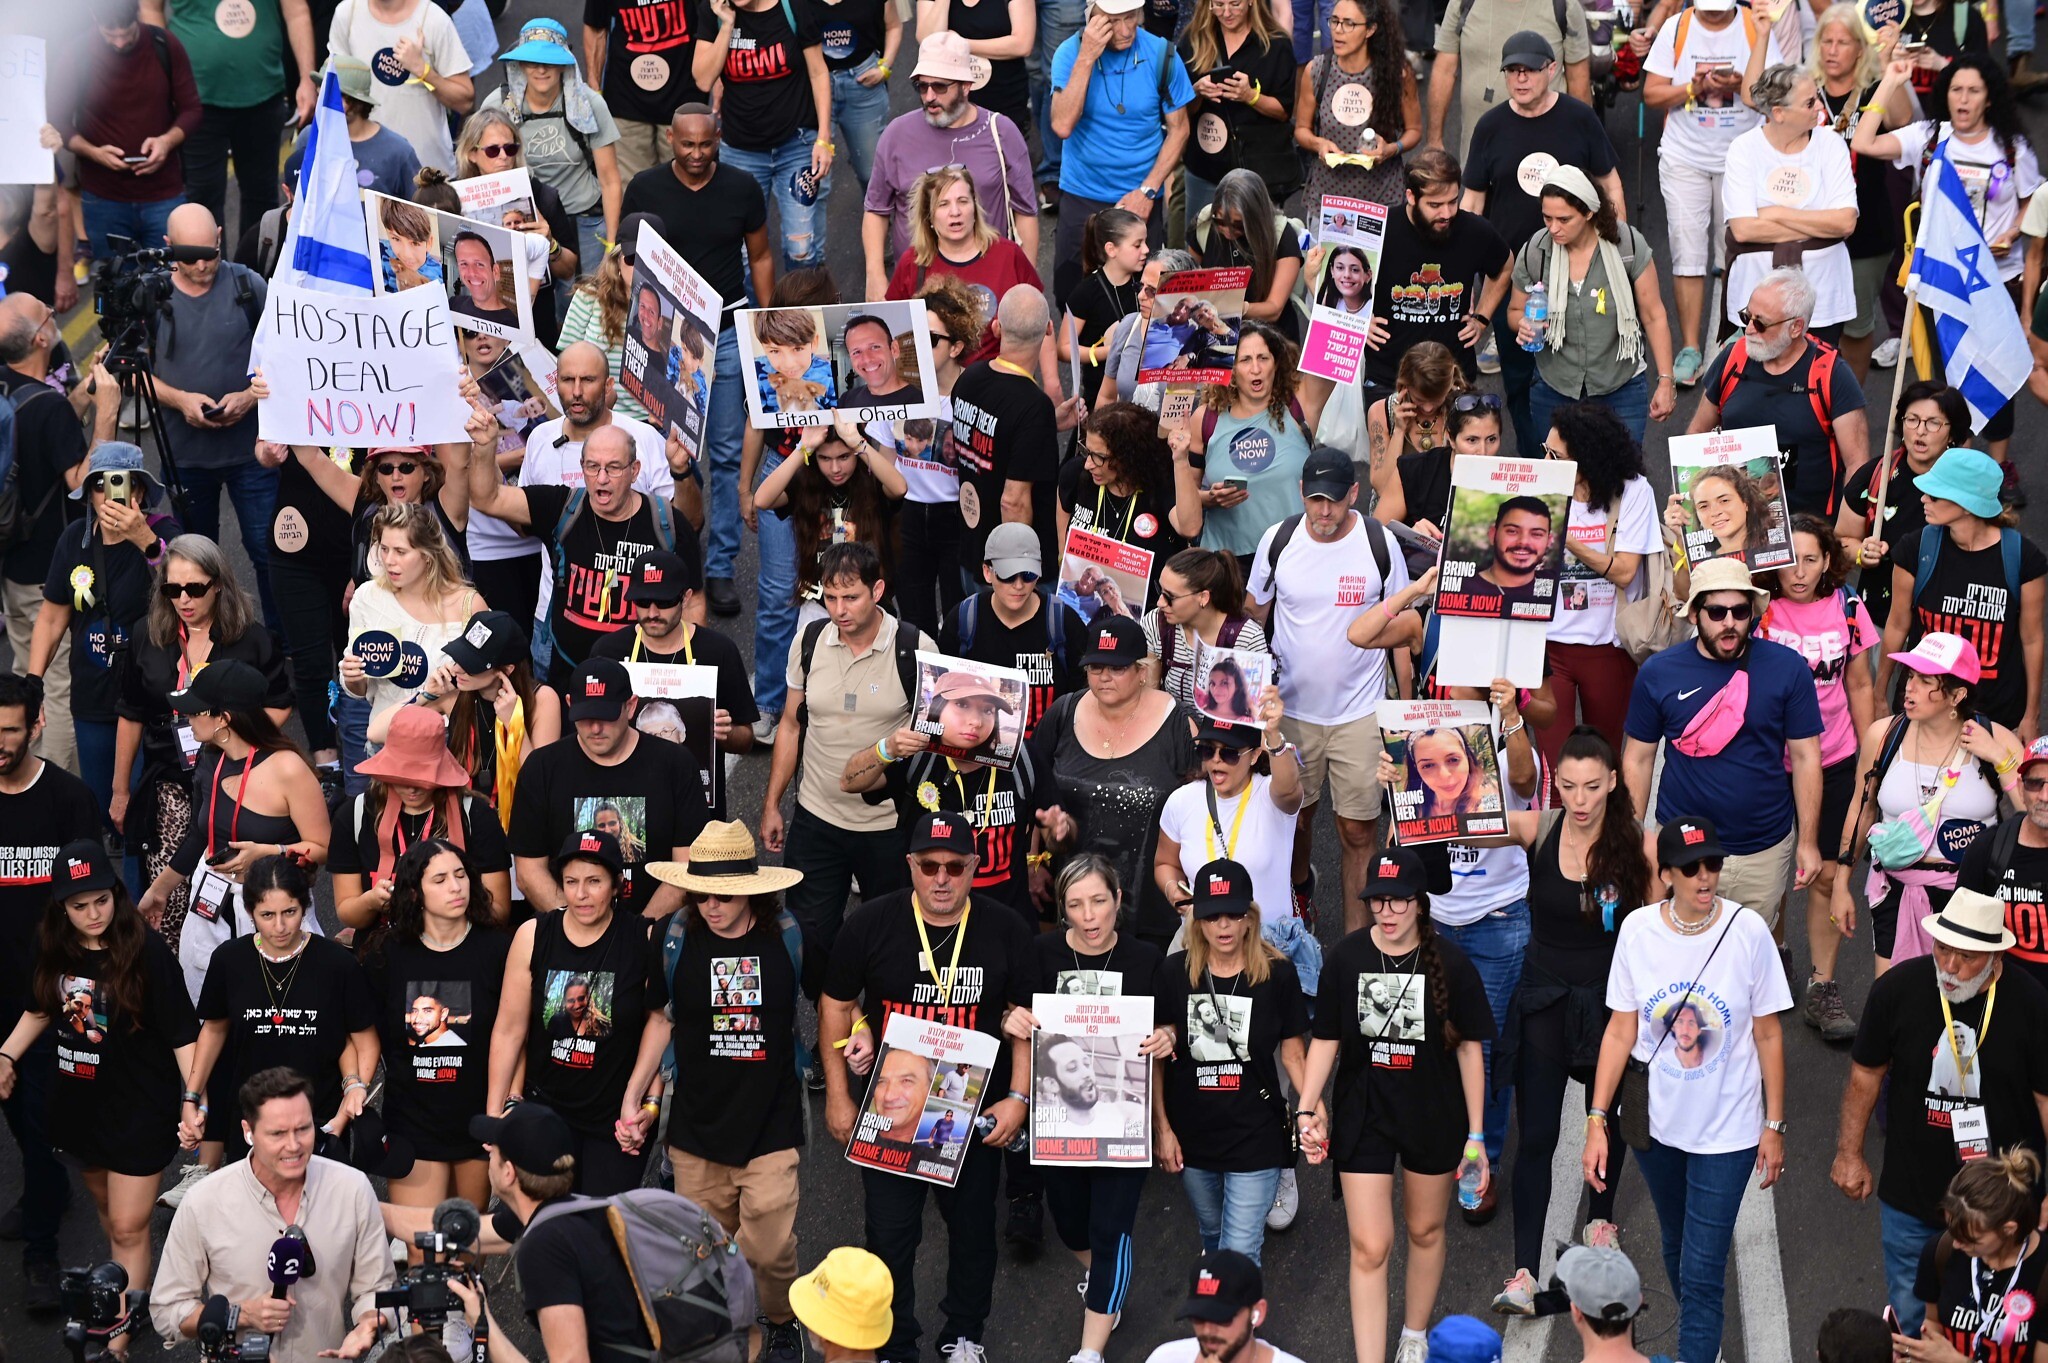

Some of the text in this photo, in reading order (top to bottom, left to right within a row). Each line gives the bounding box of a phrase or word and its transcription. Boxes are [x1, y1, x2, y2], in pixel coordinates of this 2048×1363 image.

[1874, 7, 1899, 23] NOW
[824, 30, 851, 38] HOME
[827, 38, 850, 46] NOW
[726, 43, 787, 78] NOW!
[378, 61, 402, 78] NOW
[1325, 198, 1384, 215] KIDNAPPED
[1209, 282, 1245, 291] KIDNAPPED
[276, 295, 449, 350] HOSTAGE
[1394, 313, 1407, 321] OR
[1410, 315, 1430, 323] NOT
[1450, 312, 1460, 320] BE
[472, 319, 503, 336] אוהד
[1330, 329, 1362, 346] יחד ננצח
[626, 334, 648, 368] BRING
[1327, 340, 1359, 358] רק כשכל
[624, 352, 645, 382] THEM
[1323, 352, 1356, 369] החטופים
[307, 357, 423, 393] DEAL
[1332, 366, 1353, 379] יחזרו.
[622, 368, 665, 418] HOME NOW!
[1169, 403, 1190, 411] רוצה
[307, 398, 417, 442] NOW!
[775, 407, 909, 428] Eitan Ohad
[954, 396, 998, 437] BRING THEM
[972, 430, 992, 458] NOW!
[1235, 438, 1268, 450] HOME
[1703, 444, 1742, 455] INBAR HAIMAN
[1239, 449, 1267, 460] NOW
[1491, 472, 1538, 483] OMER WENKERT
[1507, 483, 1519, 493] (22)
[1686, 528, 1714, 547] BRING
[1069, 547, 1110, 565] MURDERED
[1689, 545, 1708, 562] HER
[644, 570, 662, 581] NOW
[1113, 562, 1146, 577] KIDNAPPED
[1442, 560, 1475, 578] BRING
[1339, 576, 1366, 584] #BRING
[1441, 576, 1462, 593] HIM
[1338, 592, 1365, 603] NOW!
[1967, 583, 2008, 604] מחזירים
[1438, 592, 1503, 612] HOME NOW!
[1942, 595, 2006, 622] אותם הביתה
[359, 641, 394, 652] HOME
[1100, 637, 1118, 648] NOW
[362, 652, 392, 663] NOW
[1016, 653, 1052, 671] מחזירים
[586, 682, 605, 694] NOW
[1404, 710, 1462, 721] MORAN STELA YANAI
[915, 720, 944, 737] BRING
[1395, 790, 1424, 807] BRING
[1396, 805, 1417, 821] HER
[932, 825, 952, 836] NOW
[1399, 816, 1458, 837] HOME NOW!
[1943, 824, 1981, 841] HOME
[1683, 829, 1704, 843] NOW
[581, 839, 602, 850] NOW
[15, 846, 31, 860] AND
[70, 862, 90, 877] NOW
[1379, 864, 1399, 875] NOW
[1210, 881, 1230, 893] NOW
[951, 985, 983, 1005] אותם
[1076, 1004, 1109, 1014] חנן יבלונקה
[1644, 980, 1731, 1029] BRING OMER HOME
[243, 1006, 317, 1021] עד שאת לא כאן.
[1064, 1014, 1121, 1024] CHANAN YABLONKA
[255, 1024, 317, 1037] הלב איתך שם.
[1086, 1025, 1099, 1034] (42)
[576, 1038, 597, 1053] ROMI
[919, 1034, 964, 1052] ITZHAK ELGARAT
[1390, 1043, 1416, 1056] HANAN
[73, 1051, 100, 1065] NIMROD
[412, 1055, 463, 1067] BRING EVYATAR
[572, 1051, 594, 1064] NOW!
[1372, 1051, 1412, 1066] HOME NOW!
[59, 1058, 95, 1077] HOME NOW!
[417, 1068, 457, 1079] HOME NOW!
[1197, 1064, 1243, 1077] BRING HANAN
[1199, 1075, 1240, 1087] HOME NOW!
[861, 1112, 892, 1131] BRING
[1036, 1106, 1067, 1123] BRING
[858, 1124, 878, 1143] HIM
[853, 1140, 911, 1167] HOME NOW!
[1036, 1138, 1098, 1155] HOME NOW!
[284, 1258, 299, 1275] 2
